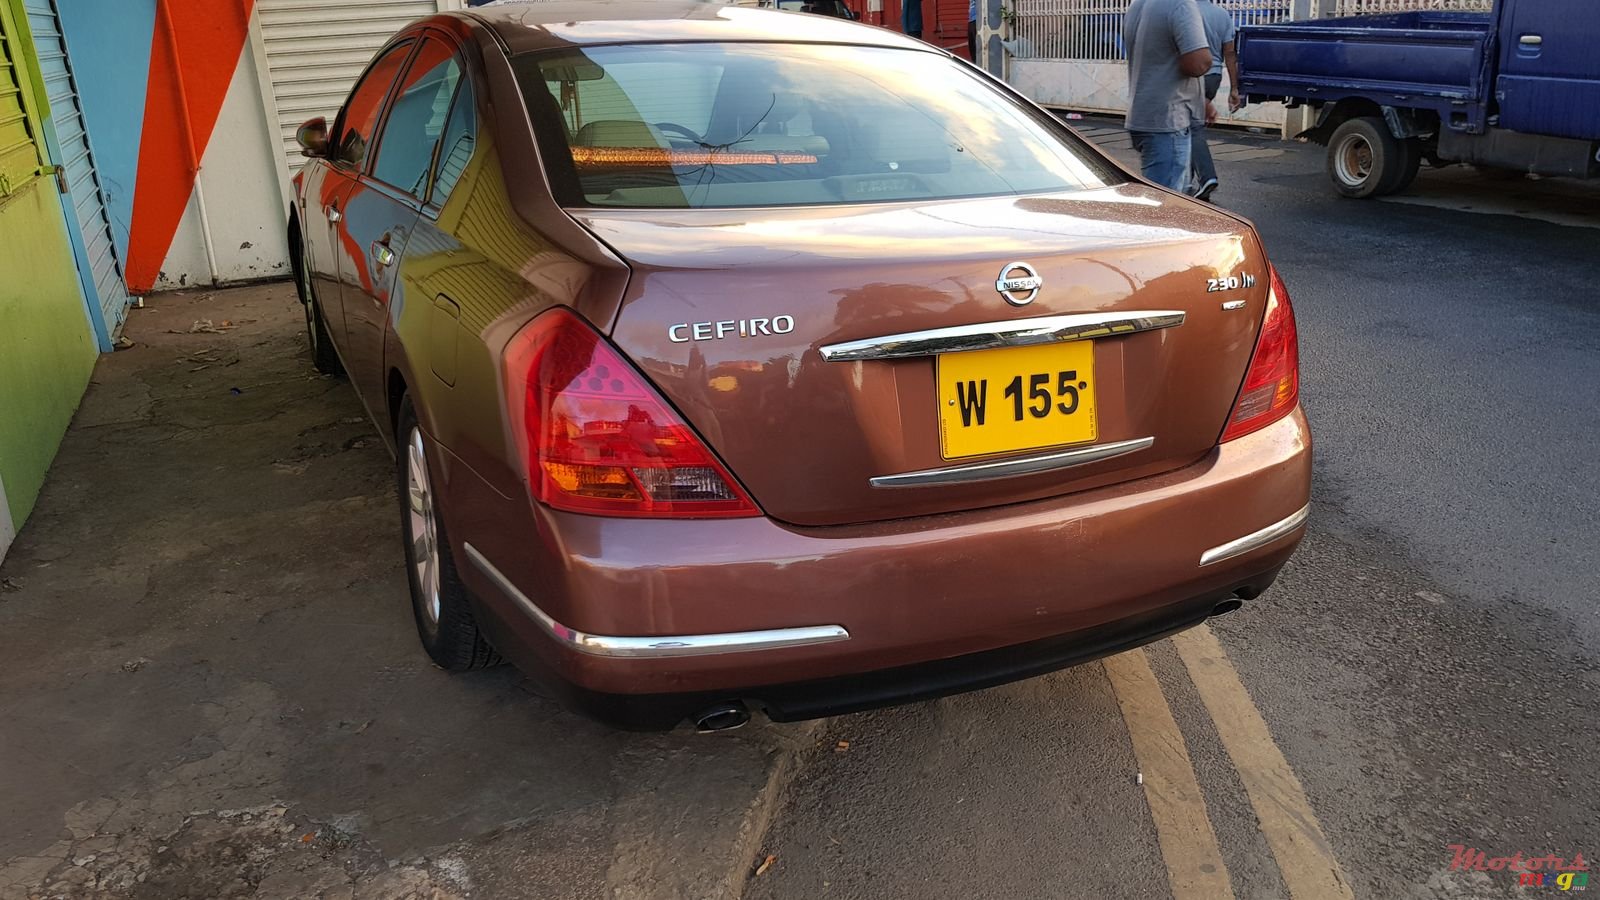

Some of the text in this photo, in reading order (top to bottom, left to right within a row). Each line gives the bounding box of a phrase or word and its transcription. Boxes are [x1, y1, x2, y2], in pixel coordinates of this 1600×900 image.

[1206, 277, 1239, 292] 230
[668, 314, 795, 343] CEFIRO
[956, 370, 1079, 427] W 155
